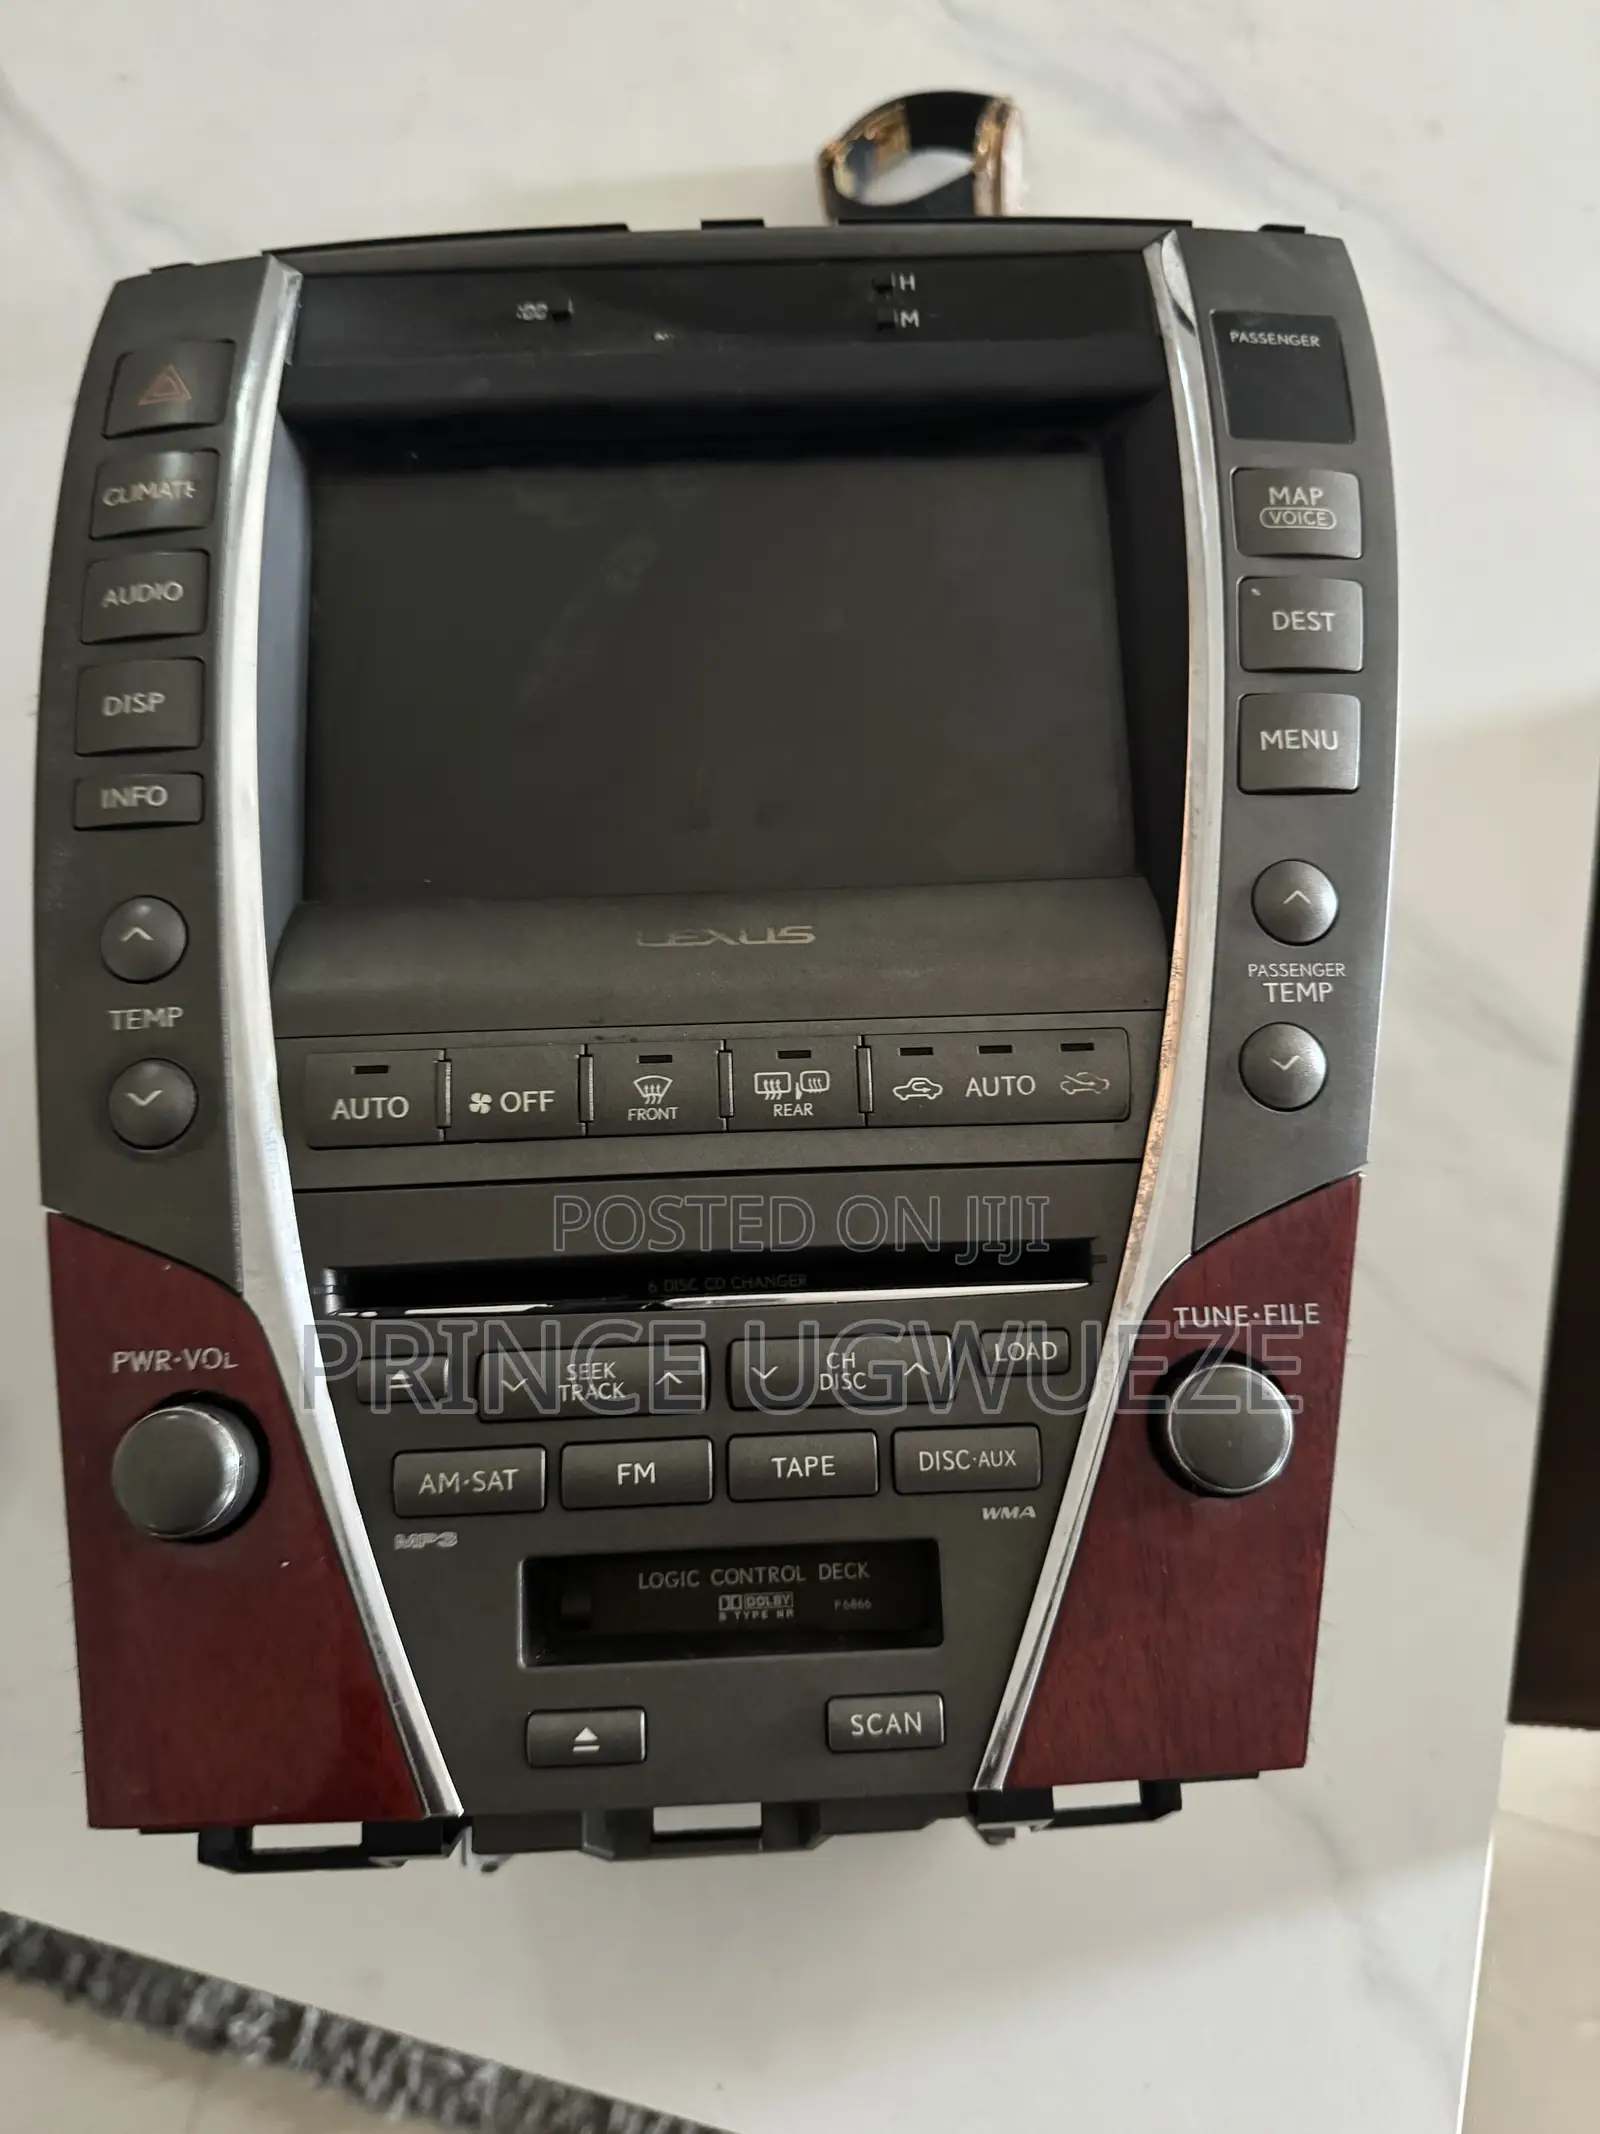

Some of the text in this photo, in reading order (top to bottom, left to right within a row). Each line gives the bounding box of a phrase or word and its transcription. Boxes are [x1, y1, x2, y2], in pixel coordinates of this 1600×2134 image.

[900, 309, 920, 328] M
[1229, 329, 1321, 348] PASSENGER
[102, 479, 196, 507] CLIMATE
[1268, 486, 1324, 507] MAP
[1268, 510, 1329, 527] VOICE
[102, 580, 184, 608] AUDIO
[1272, 610, 1336, 632] DEST
[102, 692, 166, 717] DISP
[1260, 729, 1339, 751] MENU
[101, 785, 169, 809] INFO
[636, 925, 816, 948] LEXUS
[1247, 962, 1346, 978] PASSENGER
[1263, 982, 1333, 1003] TEMP
[107, 1006, 184, 1031] TEMP
[965, 1075, 1036, 1098] AUTO
[330, 1096, 410, 1121] AUTO
[500, 1090, 556, 1113] OFF
[773, 1103, 814, 1117] REAR
[627, 1106, 680, 1121] FRONT
[664, 1278, 699, 1292] DISC
[704, 1276, 726, 1290] CD
[731, 1273, 809, 1289] CHANGER
[825, 1352, 857, 1370] CH
[994, 1341, 1058, 1362] LOAD
[566, 1361, 617, 1381] SEEK
[819, 1371, 867, 1391] DISC
[558, 1383, 627, 1402] TRACK
[616, 1461, 657, 1485] FM
[771, 1455, 837, 1478] TAPE
[981, 1505, 1037, 1520] WMA
[393, 1531, 459, 1550] MP3
[638, 1561, 870, 1590] LOGIC CONTROL DECK
[746, 1594, 790, 1608] DOLBY
[734, 1609, 769, 1620] TYPE
[850, 1711, 922, 1736] SCAN
